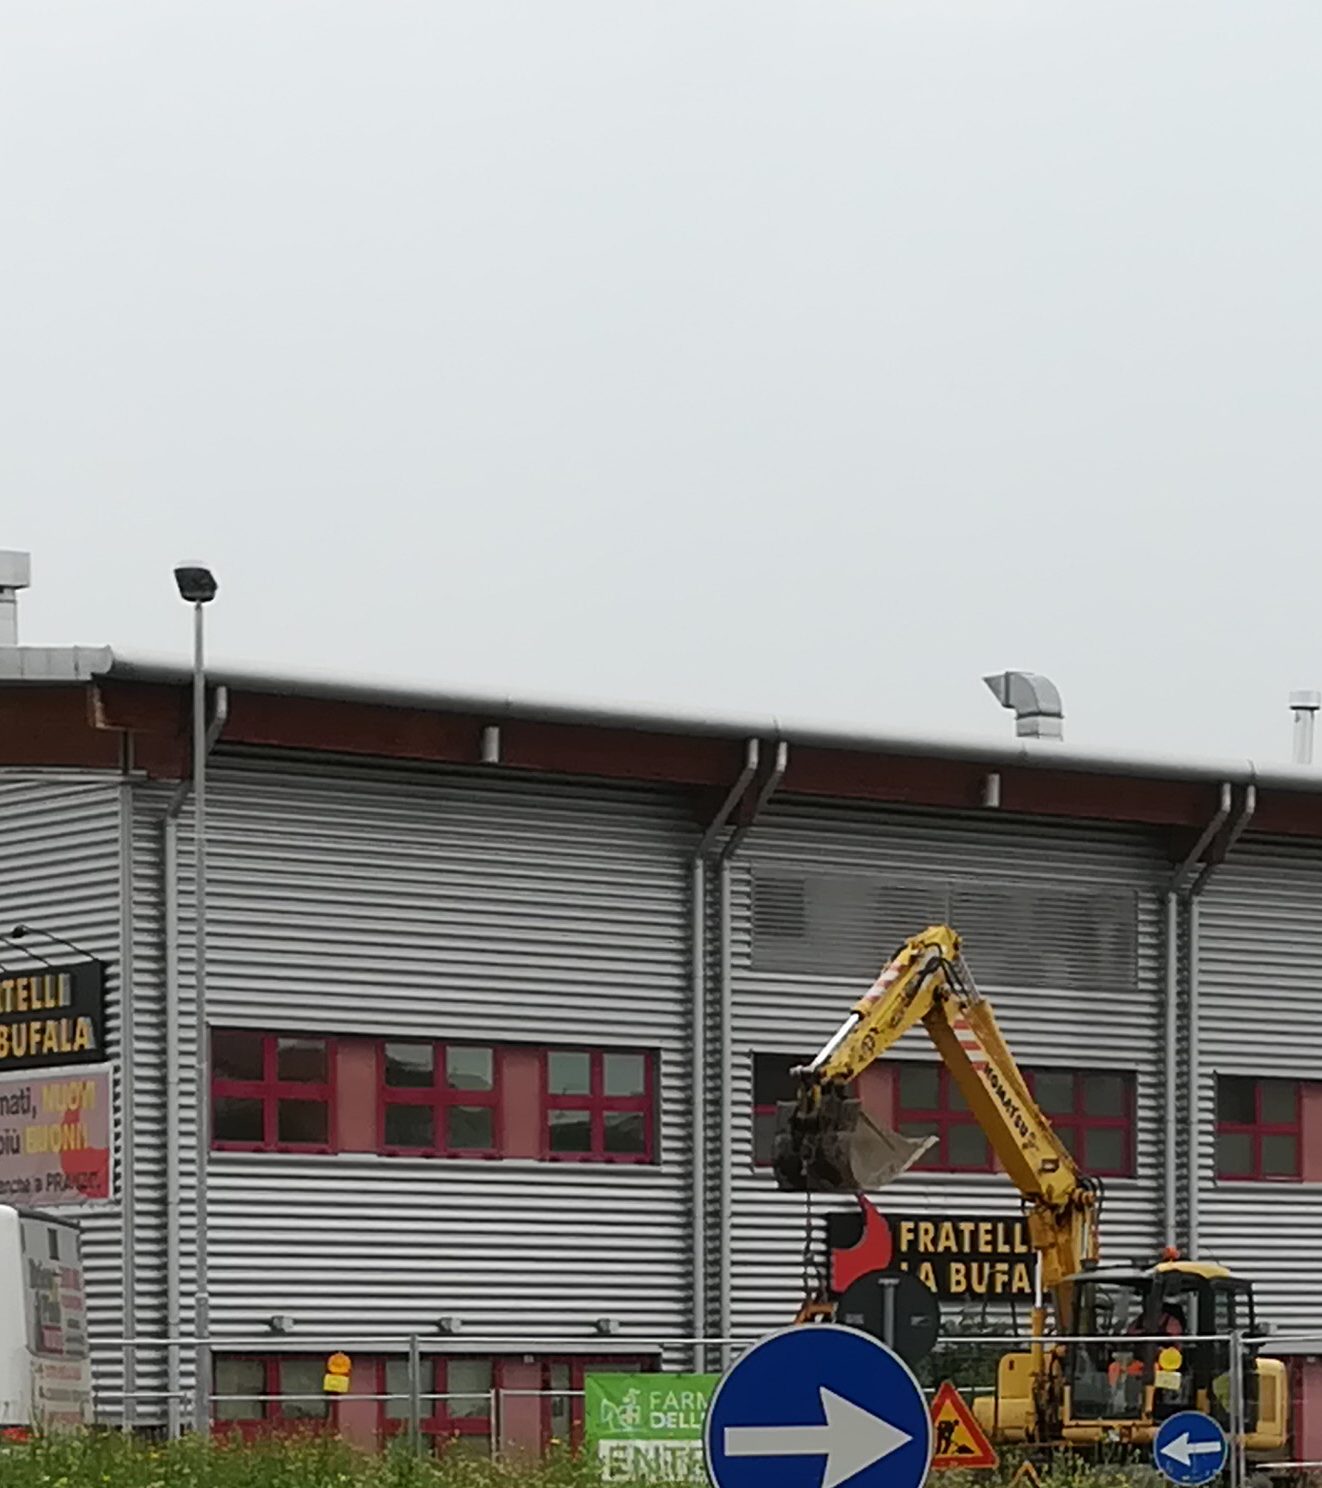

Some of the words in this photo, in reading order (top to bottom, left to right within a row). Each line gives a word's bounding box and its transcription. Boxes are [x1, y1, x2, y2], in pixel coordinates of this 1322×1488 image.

[984, 1061, 1029, 1138] KOMATSU
[900, 1221, 1028, 1253] FRATELL
[950, 1261, 1033, 1294] BUFA
[650, 1390, 708, 1410] FARM
[650, 1411, 706, 1429] DELL
